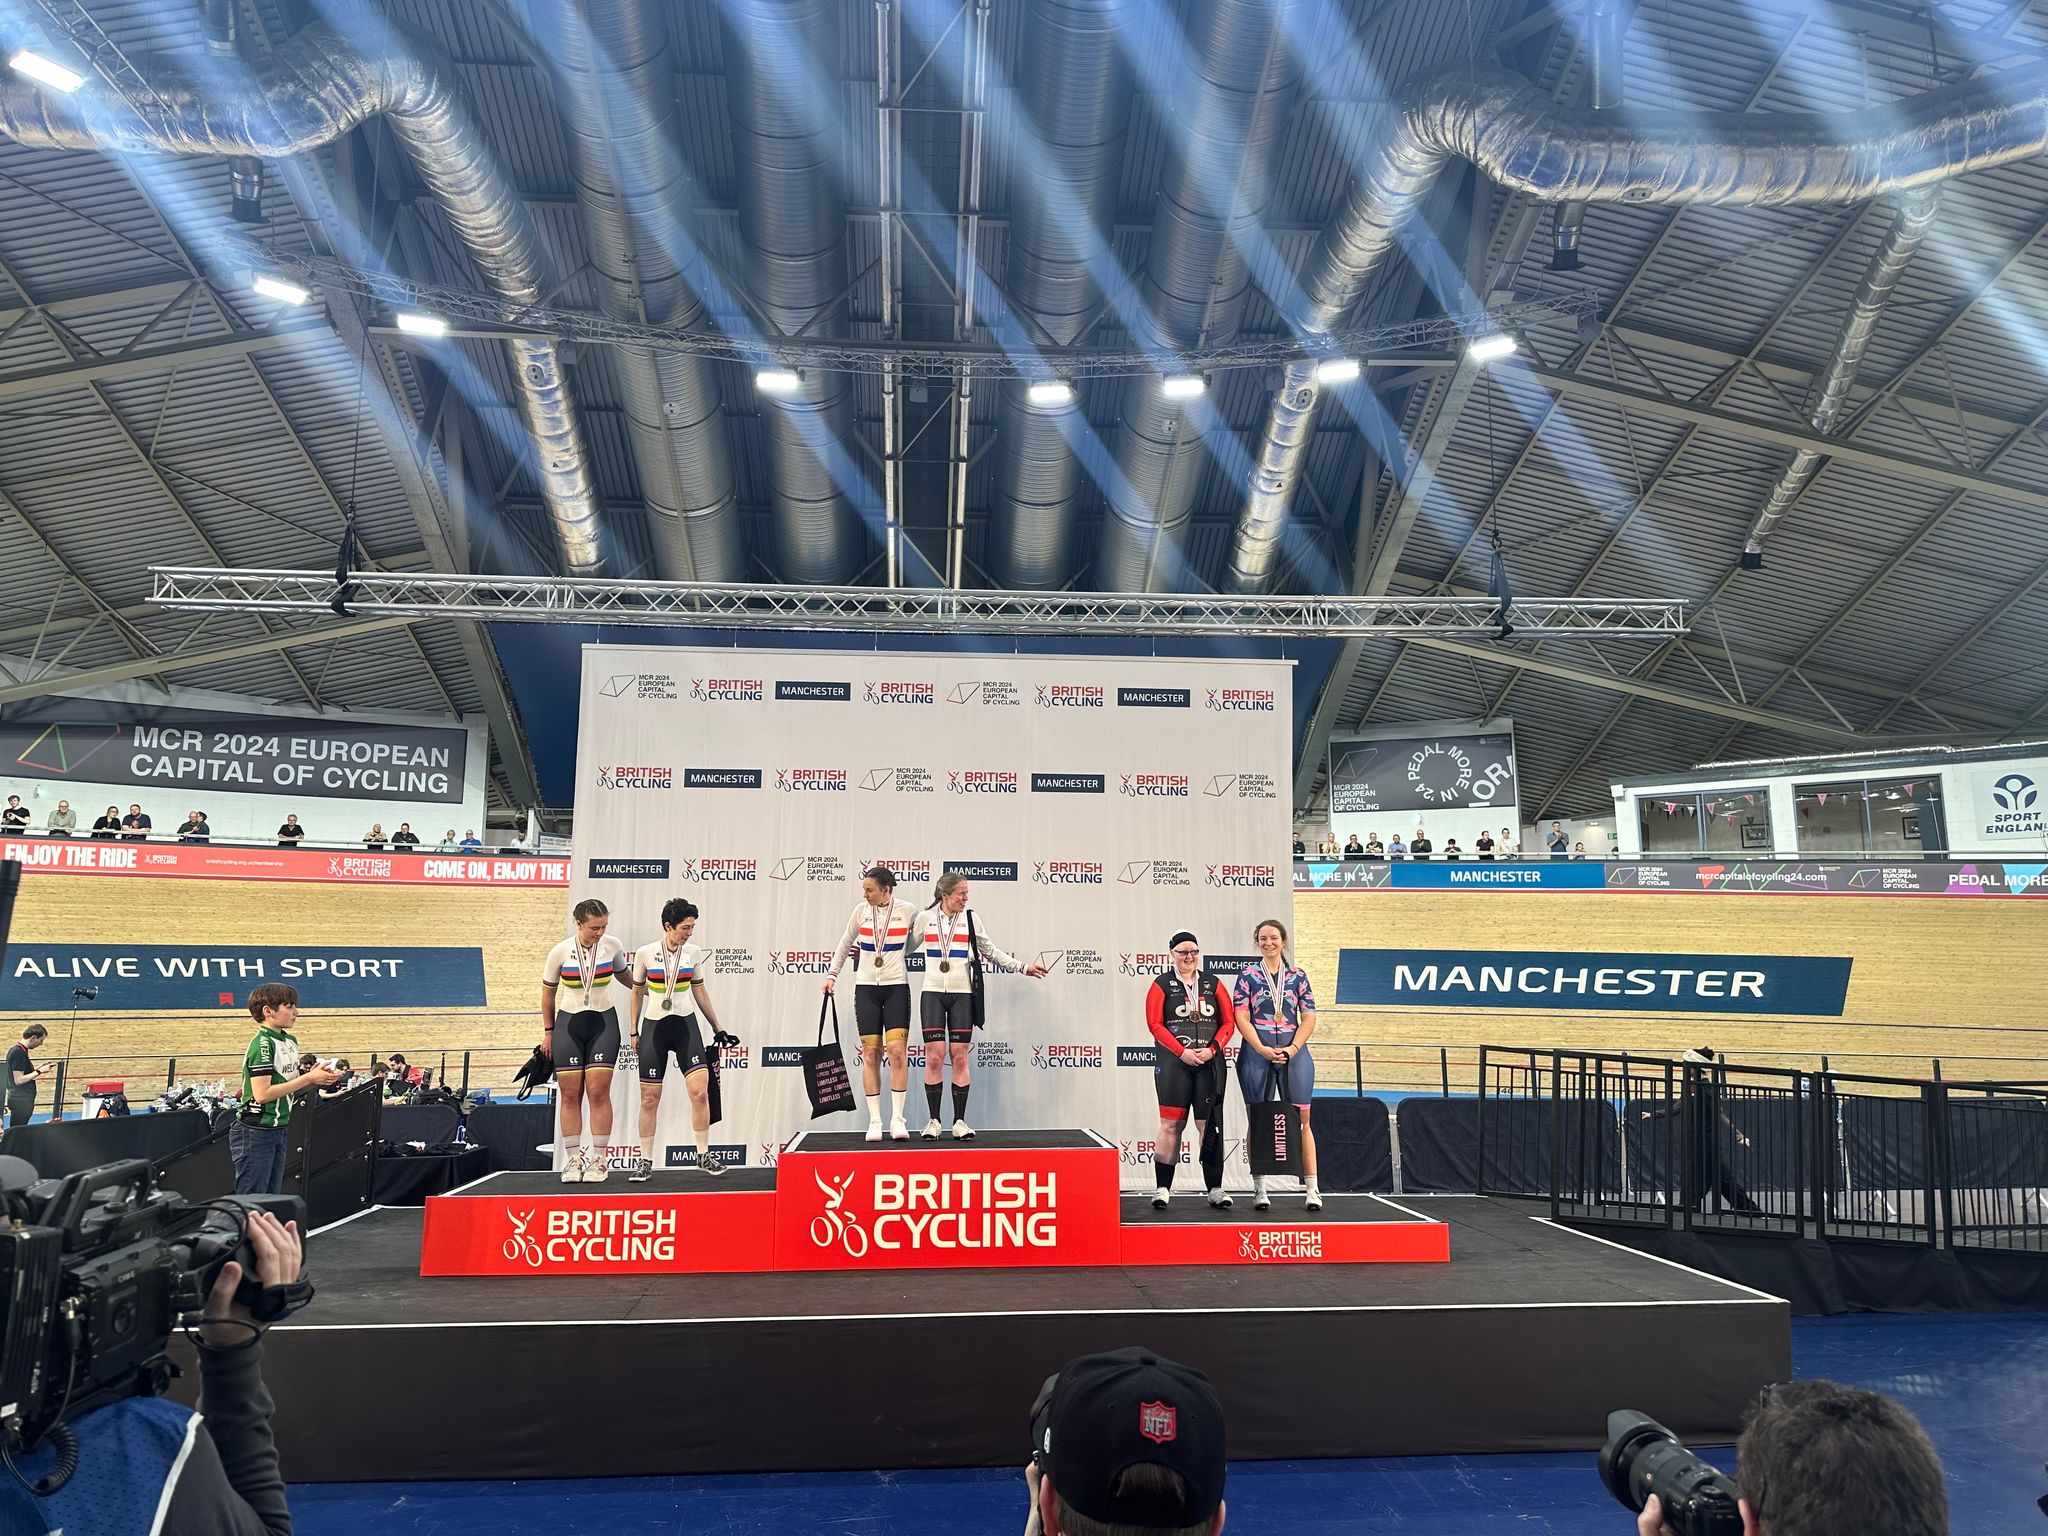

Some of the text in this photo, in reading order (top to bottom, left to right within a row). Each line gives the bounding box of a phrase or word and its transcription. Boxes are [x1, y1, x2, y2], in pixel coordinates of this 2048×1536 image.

[708, 679, 762, 690] BRITISH
[881, 682, 934, 694] BRITISH
[708, 690, 762, 700] CYCLING
[782, 686, 844, 696] MANCHESTER
[1051, 686, 1103, 696] BRITISH
[1222, 690, 1274, 700] BRITISH
[881, 694, 934, 704] CYCLING
[1051, 696, 1103, 707] CYCLING
[1124, 693, 1184, 703] MANCHESTER
[1222, 700, 1274, 711] CYCLING
[133, 726, 449, 768] MCR 2024 EUROPEAN
[1408, 742, 1444, 780] PEDAL
[616, 767, 672, 778] BRITISH
[1448, 746, 1472, 790] MORE
[130, 754, 448, 794] CAPITAL OF CYCLING
[690, 774, 755, 784] MANCHESTER
[793, 769, 846, 780] BRITISH
[964, 772, 1017, 782] BRITISH
[616, 778, 672, 789] CYCLING
[793, 780, 846, 791] CYCLING
[1037, 778, 1098, 788] MANCHESTER
[1136, 775, 1188, 786] BRITISH
[964, 782, 1017, 793] CYCLING
[1136, 786, 1188, 796] CYCLING
[1440, 787, 1458, 802] IN
[1994, 812, 2041, 822] SPORT
[5, 844, 138, 868] ENJOY THE RIDE
[344, 858, 391, 868] BRITISH
[701, 859, 756, 870] BRITISH
[1050, 862, 1102, 872] BRITISH
[343, 868, 390, 877] CYCLING
[424, 860, 564, 881] COME ON, ENJOY THE
[596, 864, 663, 874] MANCHESTER
[949, 866, 1012, 876] MANCHESTER
[1222, 865, 1274, 876] BRITISH
[701, 870, 756, 881] CYCLING
[1050, 873, 1102, 884] CYCLING
[1309, 872, 1342, 882] MORE
[1344, 872, 1355, 882] IN
[1450, 871, 1541, 883] MANCHESTER
[1696, 872, 1826, 882] mcrcapitalofcycling24.com
[1948, 874, 2048, 886] PEDAL MORE
[1222, 876, 1274, 887] CYCLING
[14, 957, 404, 978] ALIVE WITH SPORT
[1394, 965, 1766, 998] MANCHESTER
[1049, 1045, 1102, 1056] BRITISH
[1049, 1057, 1102, 1068] CYCLING
[1275, 1114, 1287, 1162] LIMITLESS
[672, 1151, 739, 1161] MANESTER
[874, 1172, 1058, 1209] BRITISH
[547, 1209, 677, 1236] BRITISH
[872, 1212, 1058, 1250] CYCLING
[1259, 1231, 1321, 1245] BRITISH
[546, 1236, 676, 1262] CYCLING
[1259, 1245, 1322, 1258] CYCLING
[1144, 1416, 1171, 1436] NFL
